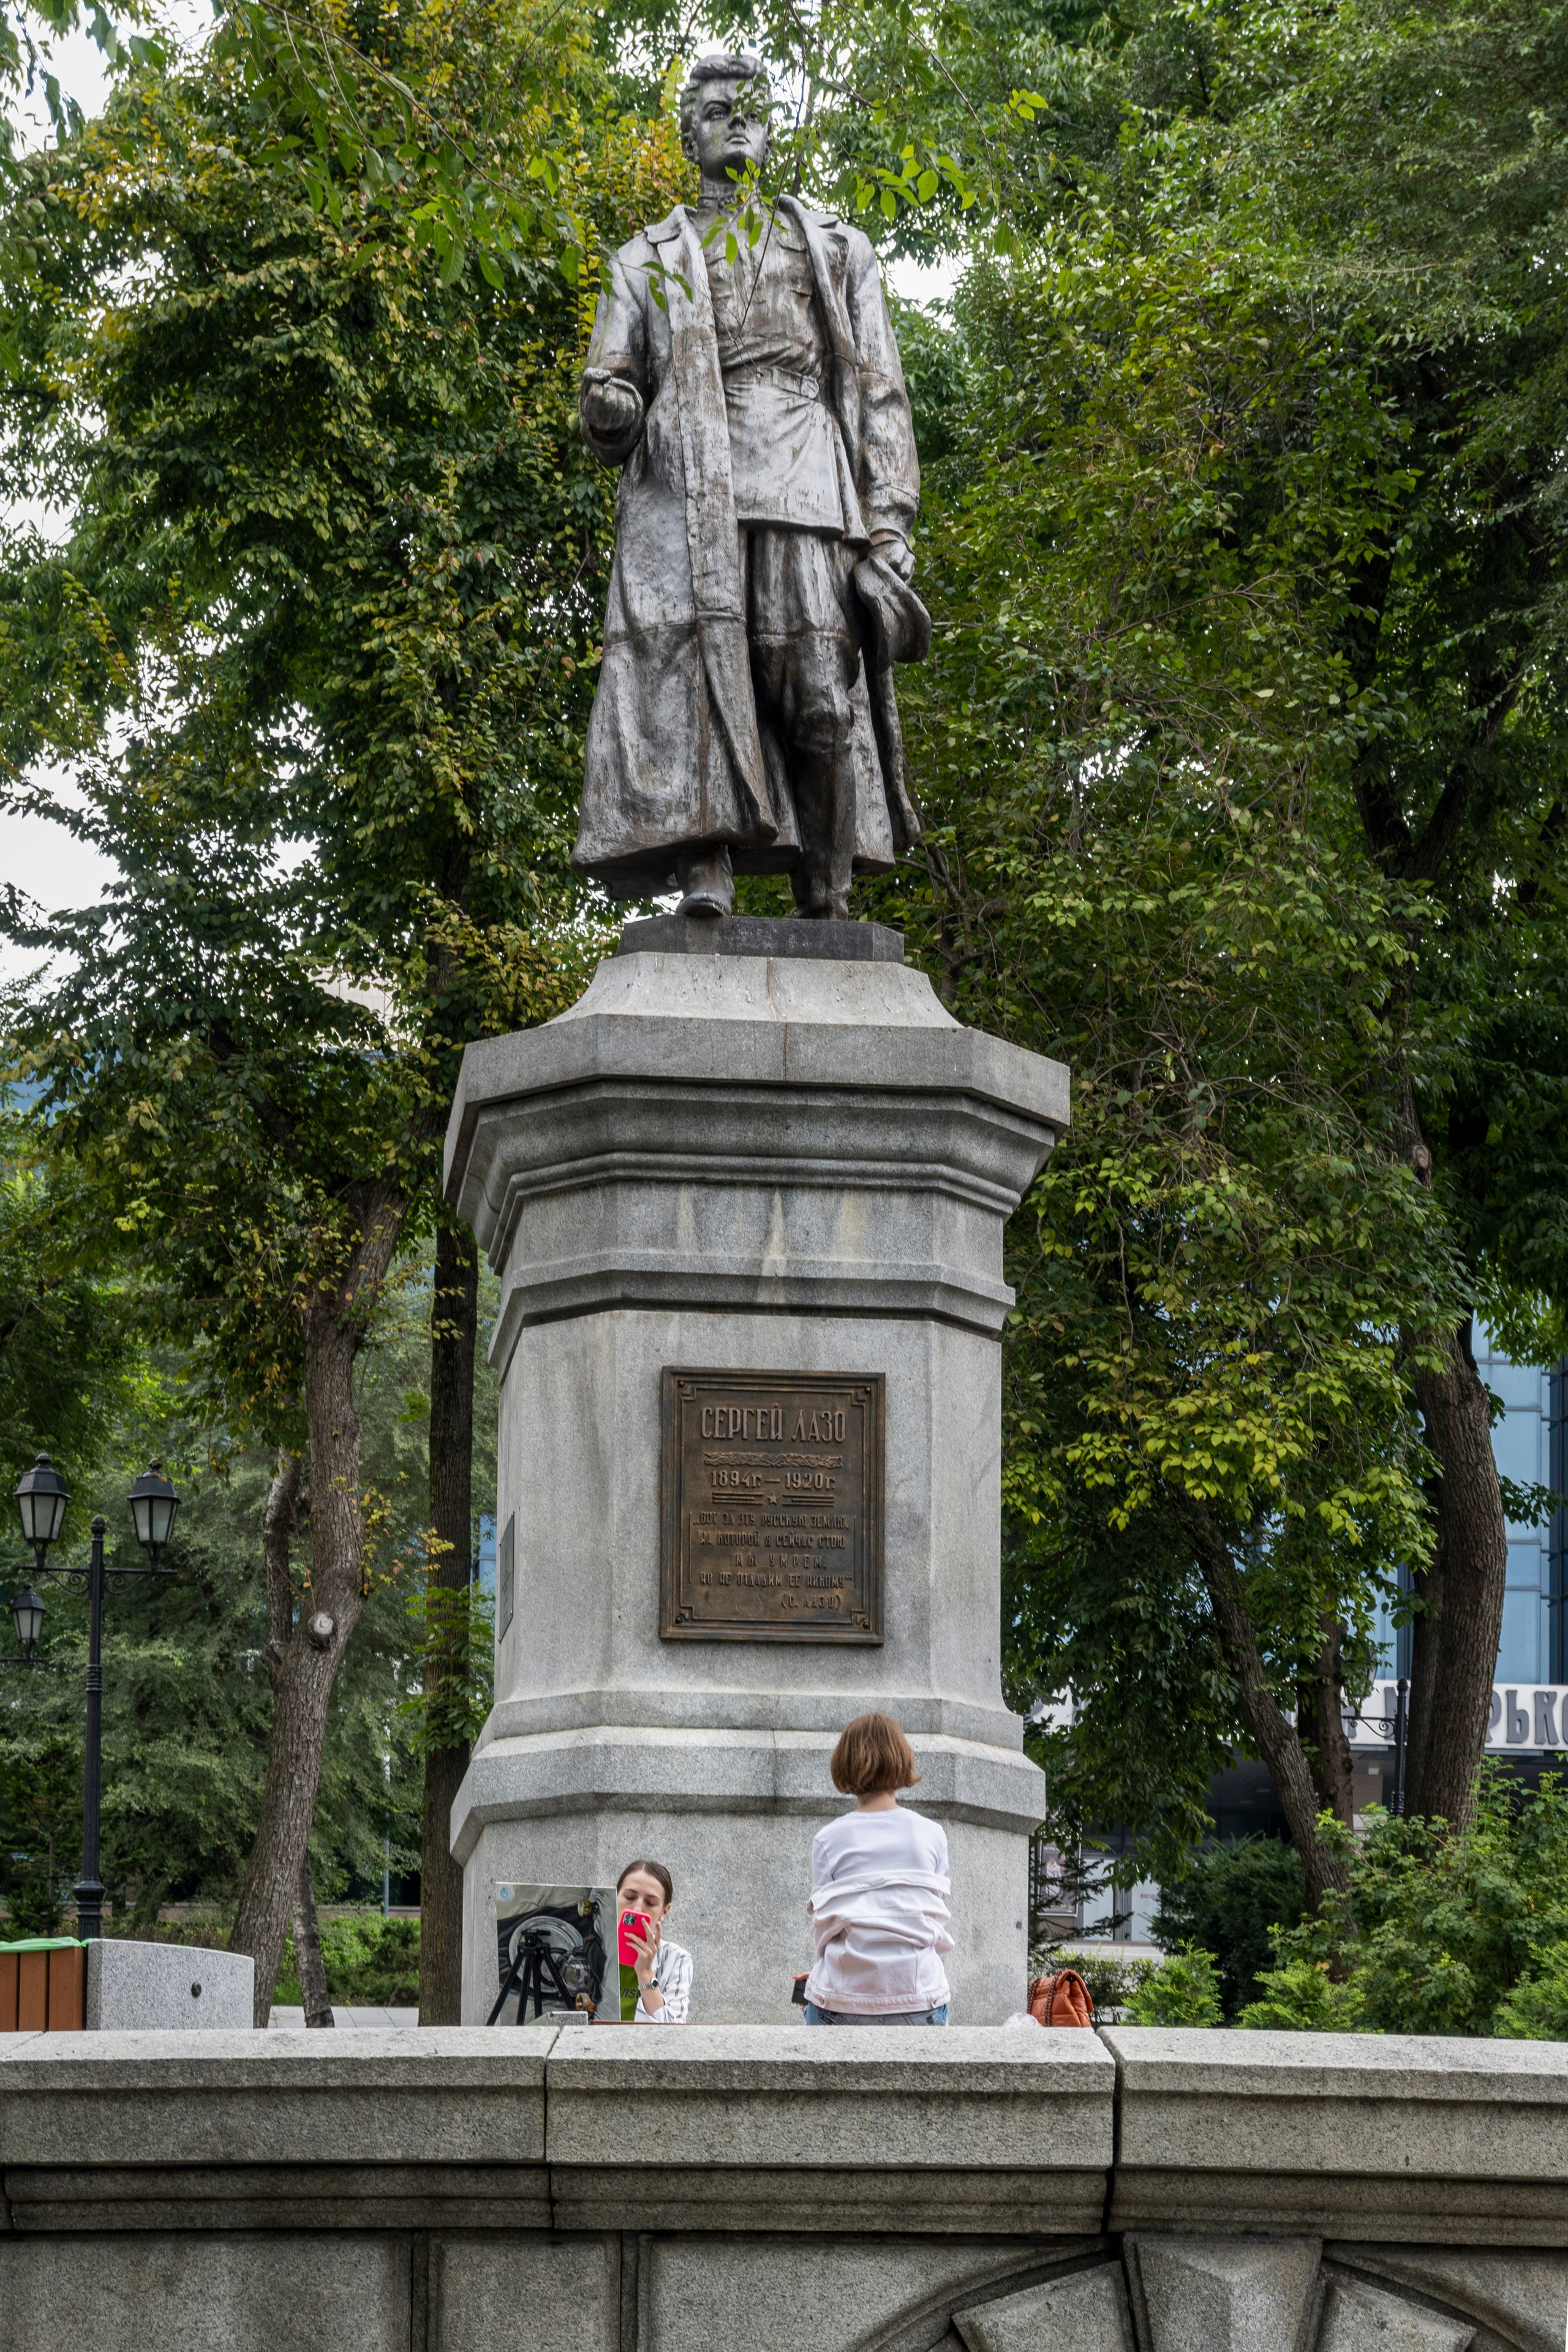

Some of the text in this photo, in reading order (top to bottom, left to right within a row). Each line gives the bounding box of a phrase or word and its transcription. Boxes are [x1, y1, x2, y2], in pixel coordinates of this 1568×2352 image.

[702, 1404, 846, 1442] СЕРГЕЙ ЛАЗО
[723, 1512, 734, 1526] ЗА
[739, 1512, 756, 1526] ЭТУ
[762, 1513, 807, 1528] РУССКУЮ
[718, 1531, 760, 1547] КОТОРОЙ
[776, 1531, 813, 1548] СЕЙЧАС
[737, 1573, 783, 1587] ОТДАДИМ
